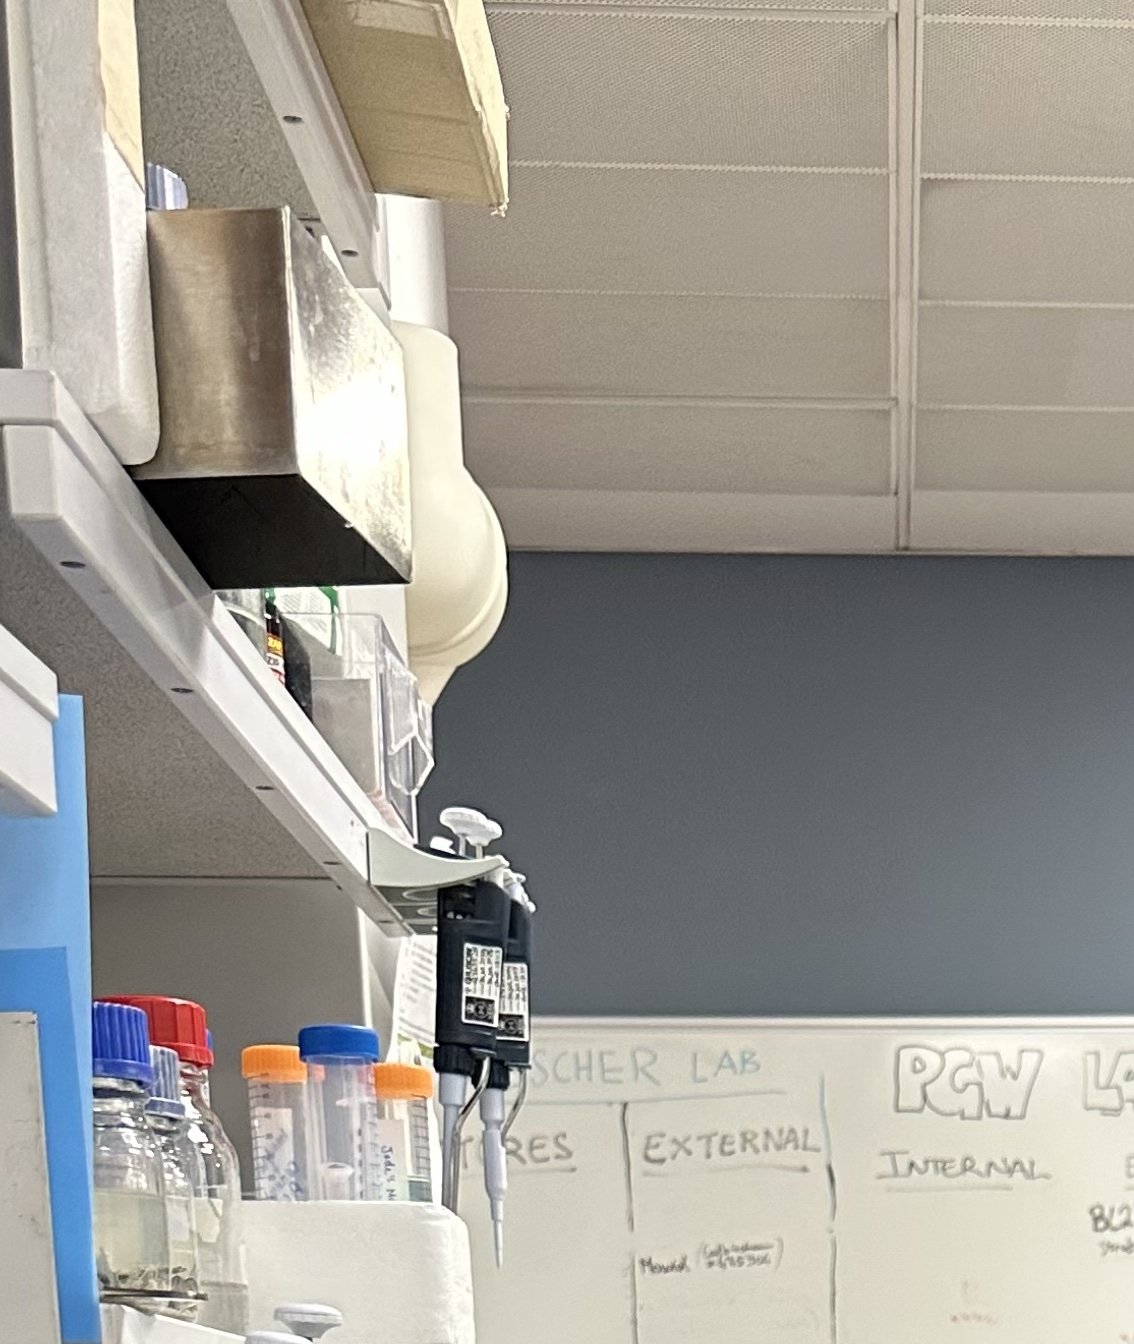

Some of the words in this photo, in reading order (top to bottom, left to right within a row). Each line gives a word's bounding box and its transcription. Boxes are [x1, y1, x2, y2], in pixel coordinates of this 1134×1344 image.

[689, 1048, 762, 1085] LAB
[894, 1045, 1044, 1120] PGW
[642, 1126, 822, 1166] EXTERNAL
[876, 1151, 1051, 1181] INTERNAL
